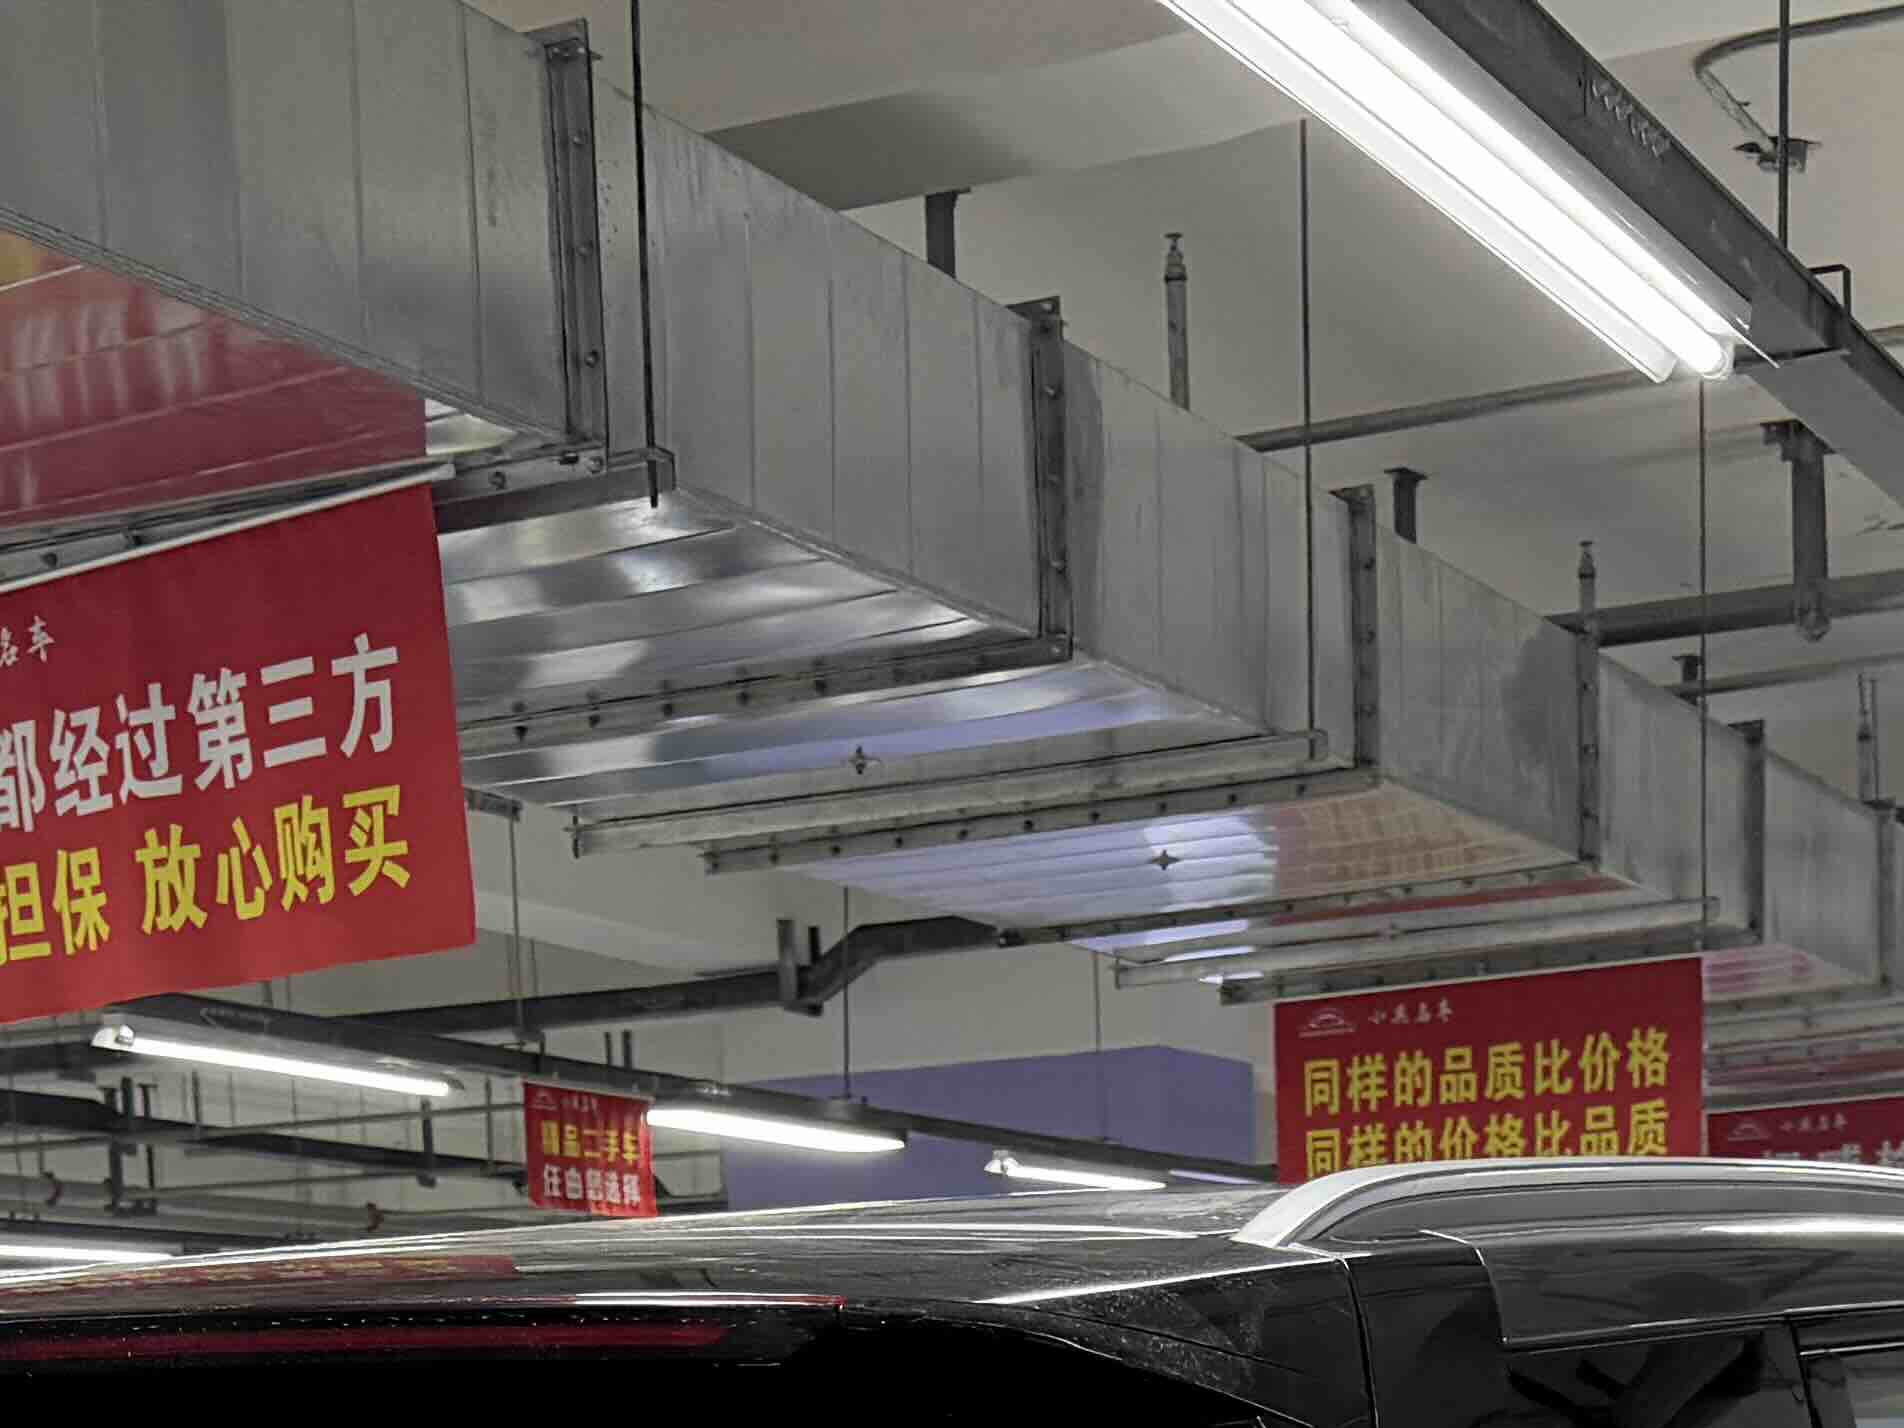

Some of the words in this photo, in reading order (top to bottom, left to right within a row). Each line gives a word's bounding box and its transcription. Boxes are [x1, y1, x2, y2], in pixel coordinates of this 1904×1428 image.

[135, 784, 410, 935] 放心购买
[1303, 1026, 1671, 1118] 同样的品质比价格
